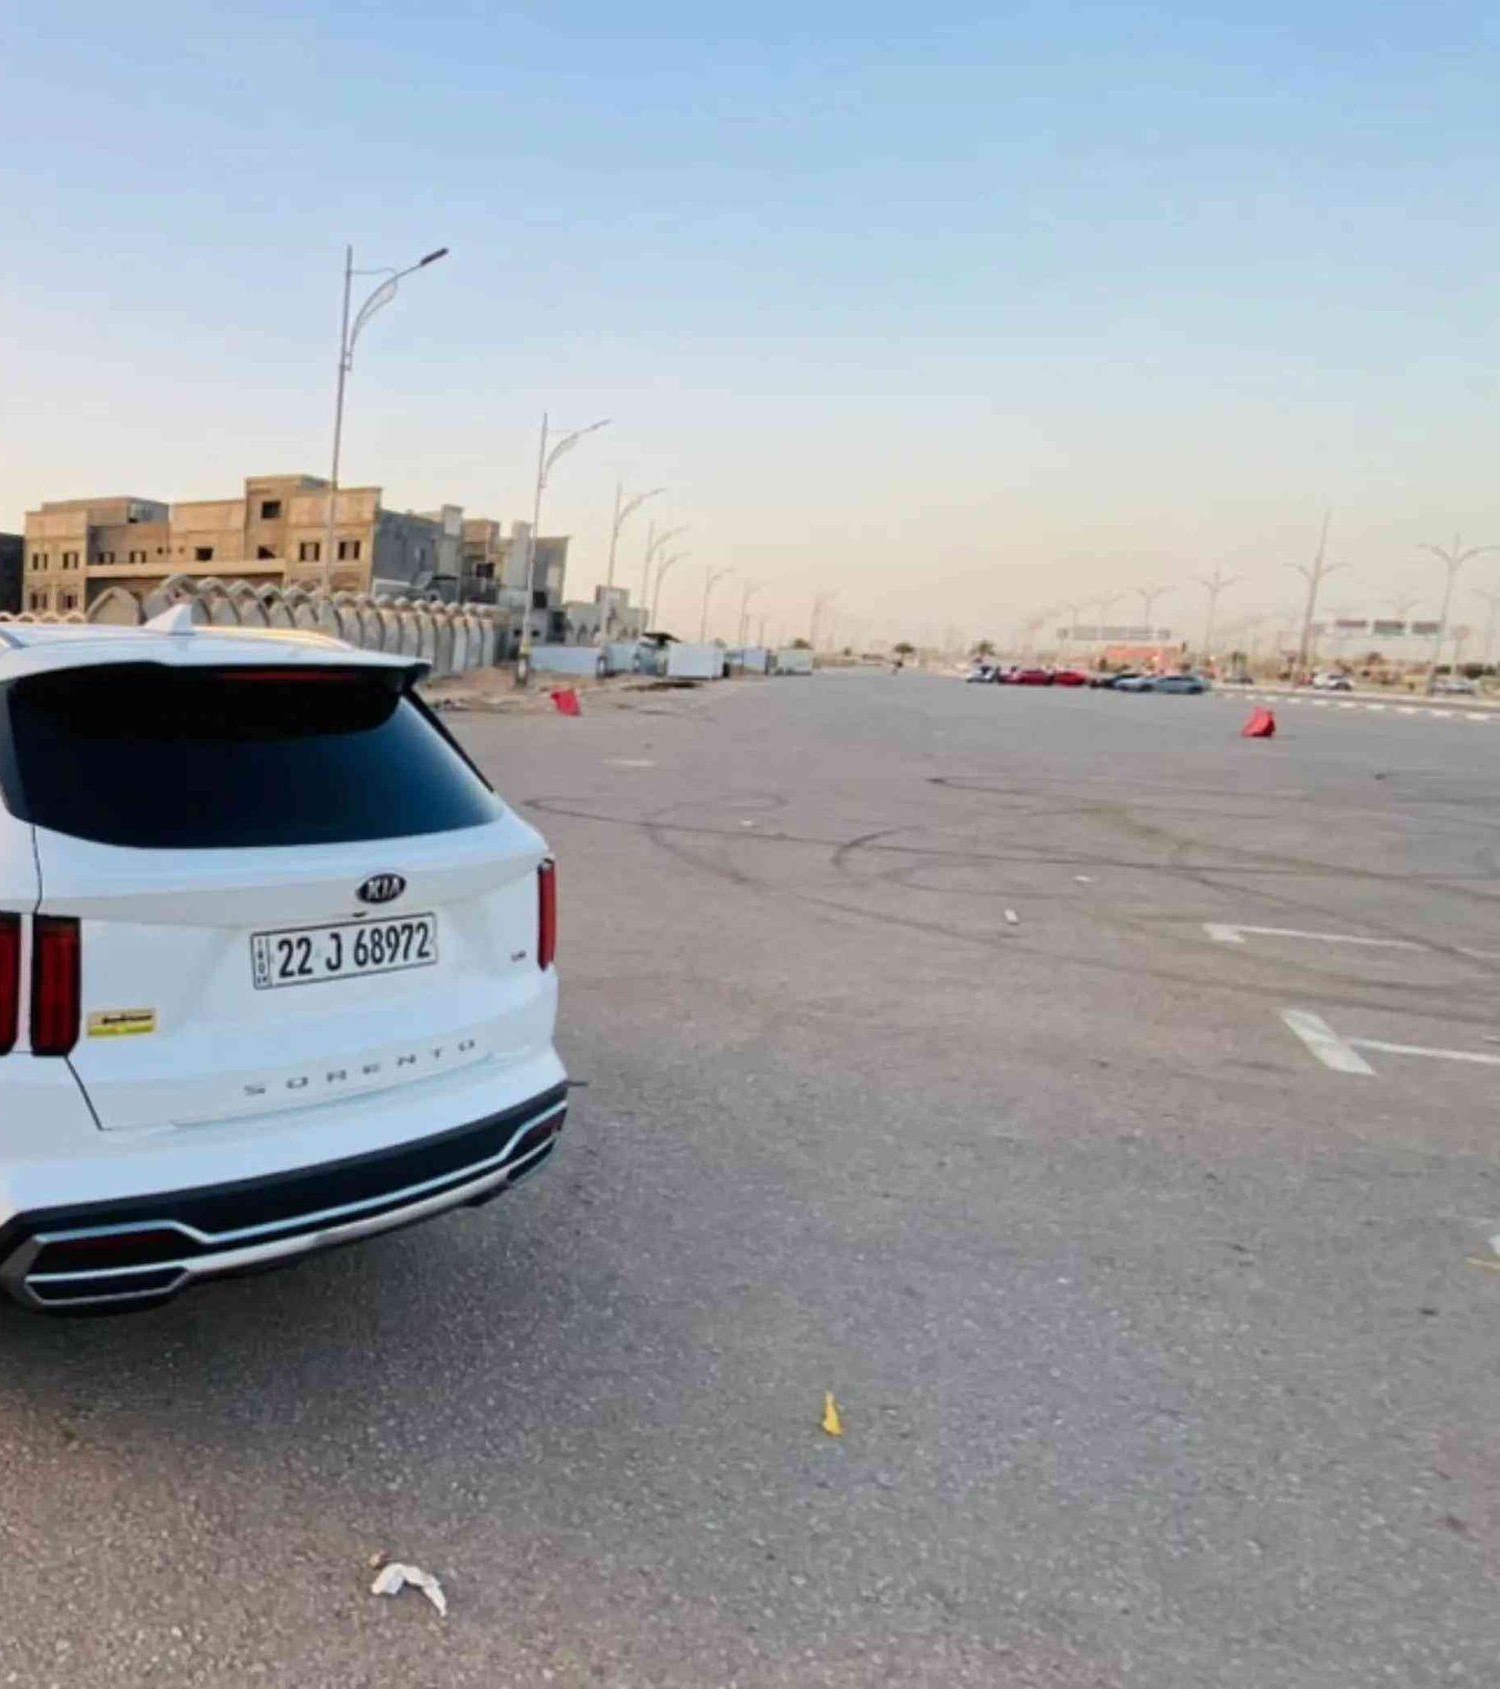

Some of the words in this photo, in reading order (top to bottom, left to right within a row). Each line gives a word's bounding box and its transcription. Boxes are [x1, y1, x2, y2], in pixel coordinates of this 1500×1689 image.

[367, 878, 402, 899] KIA
[278, 937, 313, 978] 22
[326, 932, 343, 971] J
[354, 922, 431, 967] 68972
